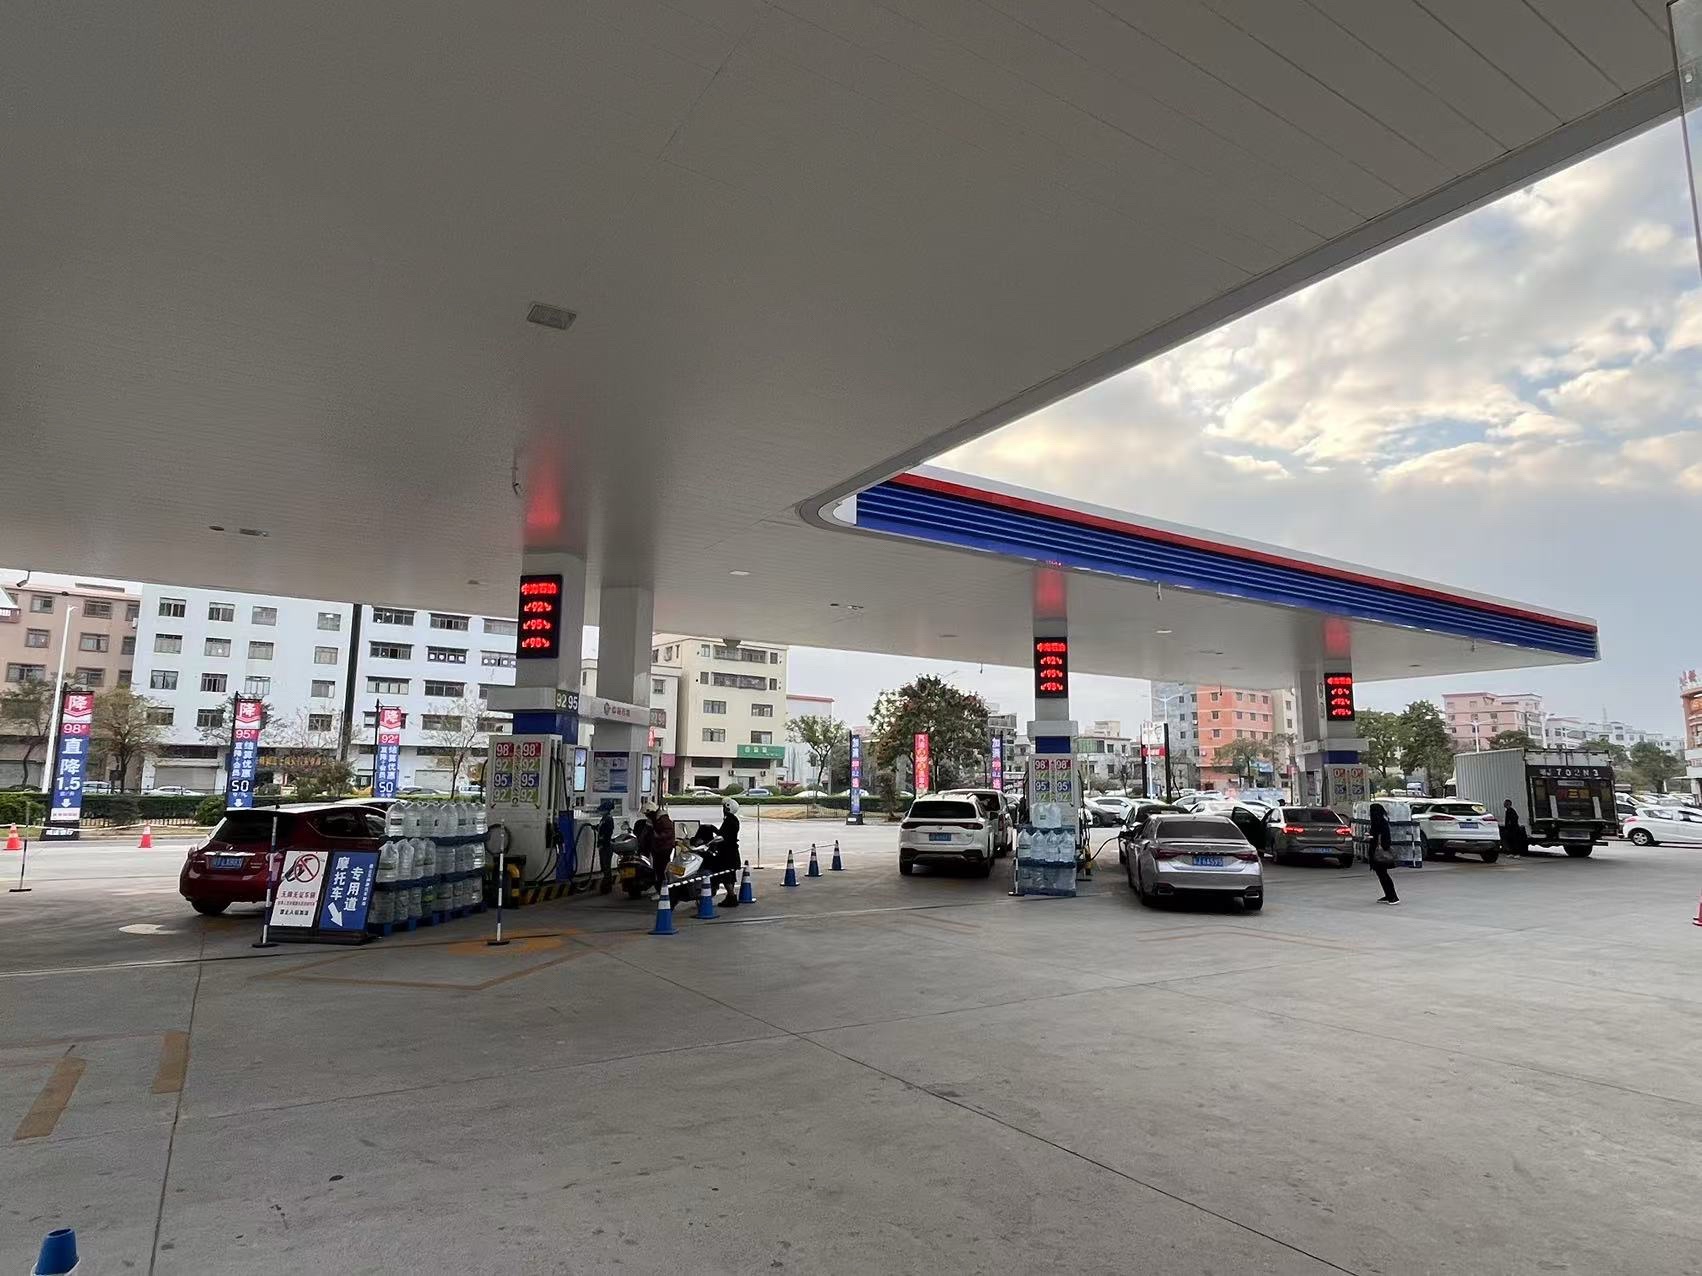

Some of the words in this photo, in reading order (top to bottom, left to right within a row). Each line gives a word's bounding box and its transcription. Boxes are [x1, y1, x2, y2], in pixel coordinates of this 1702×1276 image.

[532, 602, 543, 612] 92
[530, 619, 542, 630] 95
[68, 695, 88, 711] 降
[556, 693, 567, 708] 92
[568, 695, 578, 710] 95
[240, 702, 257, 717] 降
[384, 710, 399, 723] 降
[60, 738, 83, 775] 直降
[56, 777, 80, 791] 1.5
[330, 856, 350, 900] 摩托车
[344, 867, 364, 912] 专用道
